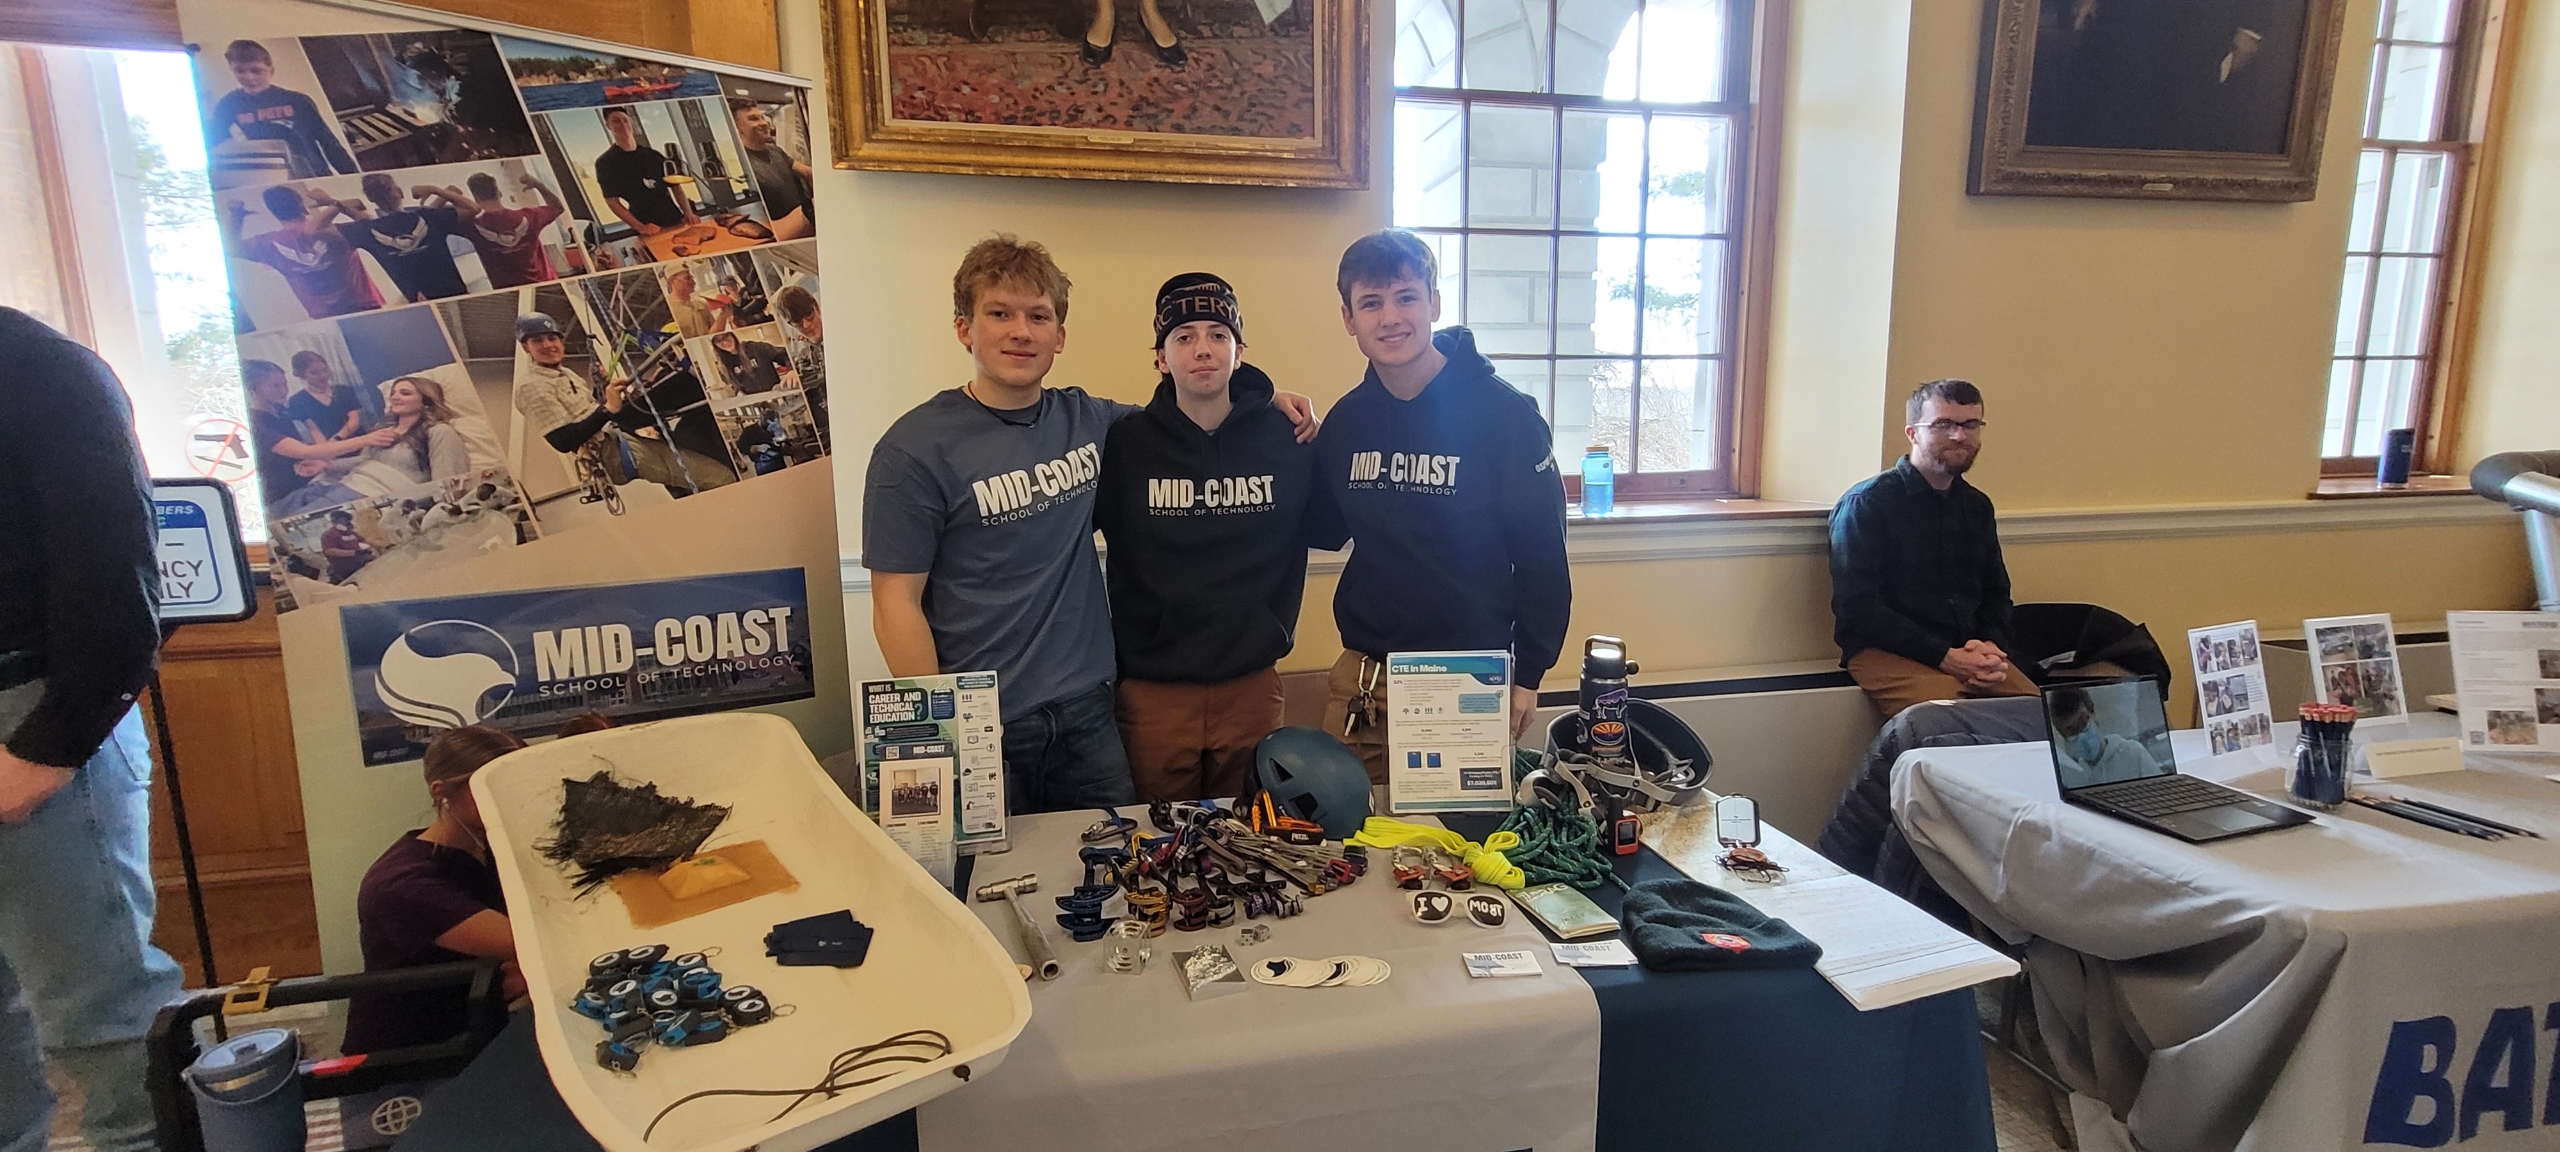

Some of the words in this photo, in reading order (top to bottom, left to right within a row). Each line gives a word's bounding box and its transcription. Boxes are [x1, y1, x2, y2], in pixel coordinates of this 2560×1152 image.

[1348, 451, 1460, 486] MID-COAST
[972, 442, 1101, 517] MID-COAST
[1148, 475, 1274, 508] MID-COAST
[1395, 483, 1457, 496] TEHNOLOGY
[157, 505, 194, 514] BERS
[981, 508, 1033, 527] SCHOOL
[1037, 500, 1051, 512] OF
[1055, 480, 1098, 506] TECHNOLO
[1149, 508, 1189, 517] SCHOOL
[1194, 508, 1207, 516] OF
[1211, 503, 1276, 516] TECHNOLOGY
[159, 560, 204, 578] NCY
[532, 606, 791, 682] MID-COAST
[1392, 665, 1409, 673] CTE
[1419, 664, 1448, 673] Maine
[538, 676, 625, 697] SCHOOL
[637, 670, 661, 685] OF
[673, 654, 795, 680] TECHNOLOGY
[868, 684, 884, 693] WHAT
[885, 684, 892, 692] IS
[868, 693, 900, 704] CAREER
[903, 691, 921, 702] AND
[869, 702, 914, 714] TECHNICAL
[869, 711, 915, 724] EDUCATION
[913, 744, 945, 754] MID-COAST
[1417, 896, 1428, 911] I
[1561, 944, 1612, 952] MID-COAST
[1473, 952, 1523, 962] MID-COAST
